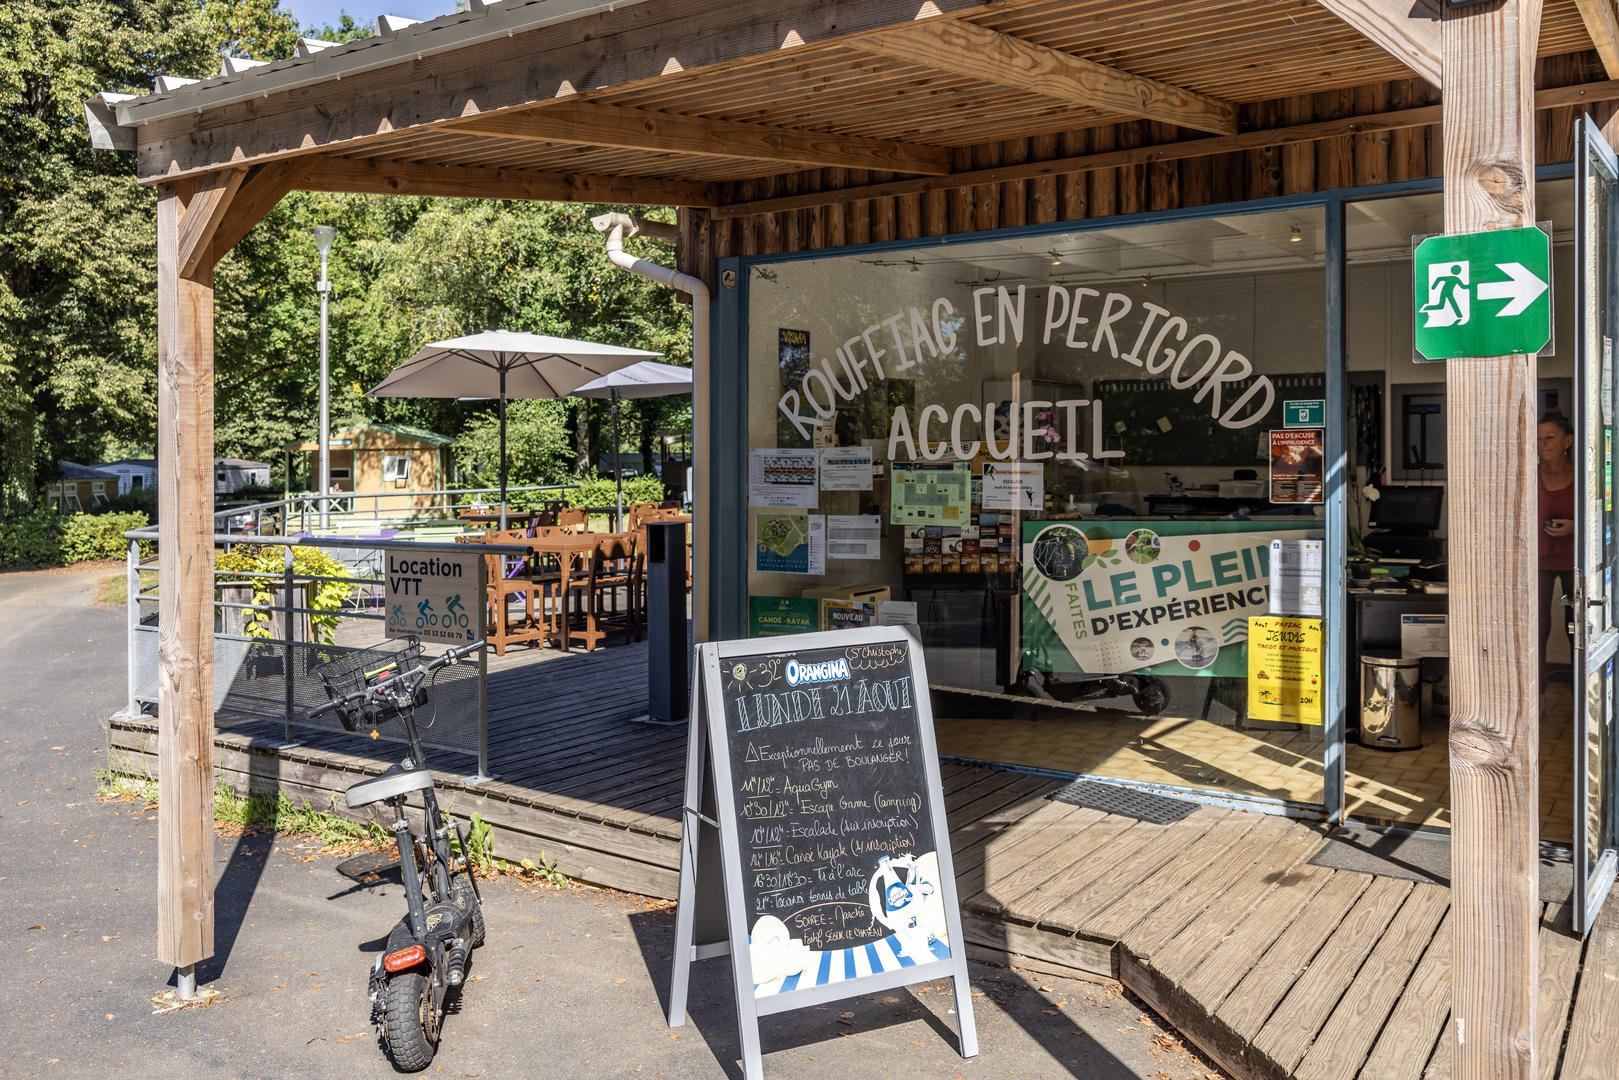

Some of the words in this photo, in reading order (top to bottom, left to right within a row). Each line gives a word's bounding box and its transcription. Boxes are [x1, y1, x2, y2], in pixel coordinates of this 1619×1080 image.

[778, 297, 958, 441] ROUFFIAC
[973, 284, 1026, 347] EN
[1043, 285, 1276, 429] PERIGORD
[887, 399, 1126, 461] ACCUEIL
[390, 556, 462, 577] Location
[390, 577, 422, 596] VTT
[1083, 571, 1141, 612] LE
[832, 612, 864, 622] NOUVEAU
[1065, 582, 1087, 640] FAITES
[1091, 585, 1270, 636] D'EXPÉRIENC
[1274, 621, 1302, 629] PAYZAC
[1288, 645, 1318, 653] MUSIQUE
[786, 658, 851, 687] ORANGINA
[735, 687, 825, 732] LUNDI
[830, 685, 853, 716] 21
[760, 733, 864, 768] Exceptionnellement
[872, 739, 884, 748] ce
[888, 735, 912, 754] jour
[799, 757, 820, 773] PAS
[825, 757, 840, 771] DE
[790, 819, 838, 838] Escalade
[817, 842, 848, 869] Kayak
[837, 863, 865, 879] l'arc
[809, 889, 833, 902] tennis
[834, 886, 846, 899] de
